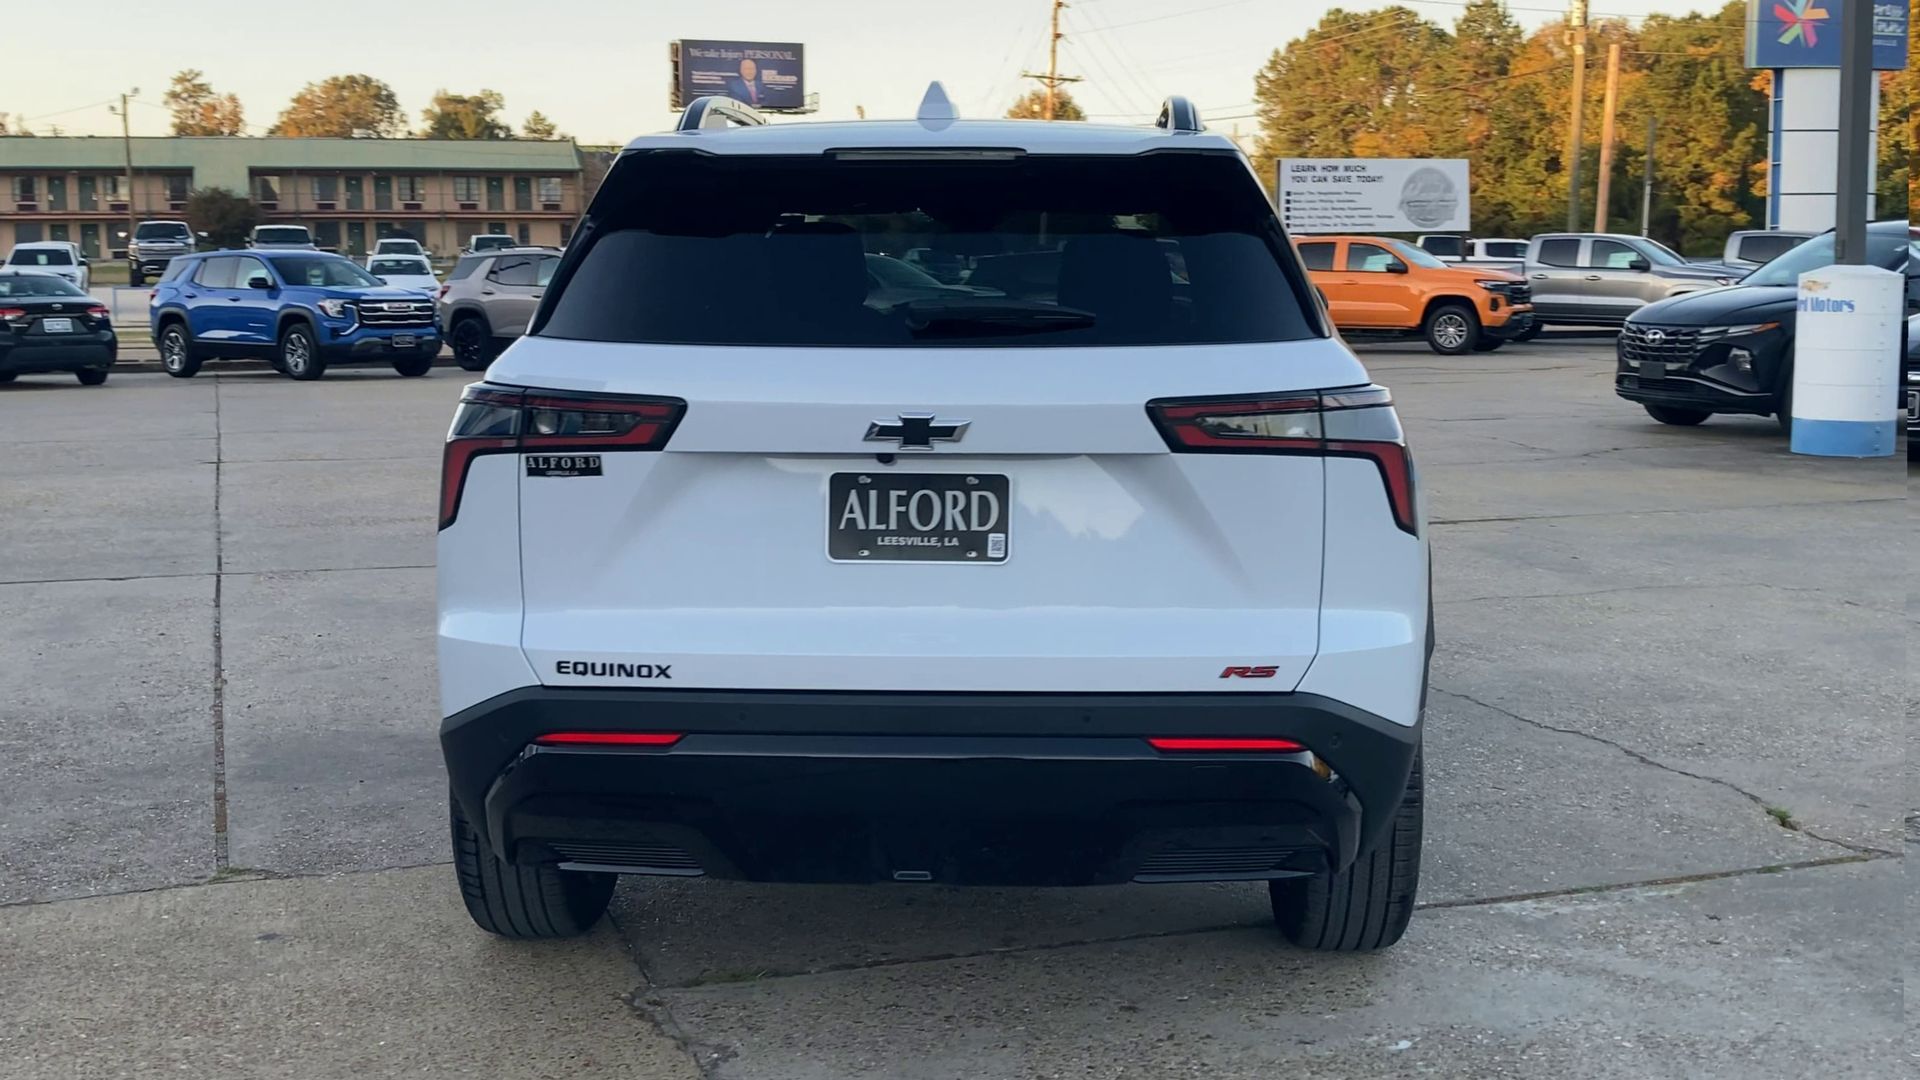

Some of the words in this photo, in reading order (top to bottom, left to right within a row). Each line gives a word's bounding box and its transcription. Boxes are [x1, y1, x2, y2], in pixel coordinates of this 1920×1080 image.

[1811, 298, 1855, 313] Motors
[527, 457, 600, 469] ALFORD
[838, 489, 1000, 532] ALFORD
[877, 536, 942, 548] LEESVILLE,
[944, 537, 959, 547] LA
[556, 660, 672, 679] EQUINOX
[1219, 665, 1280, 678] RS
